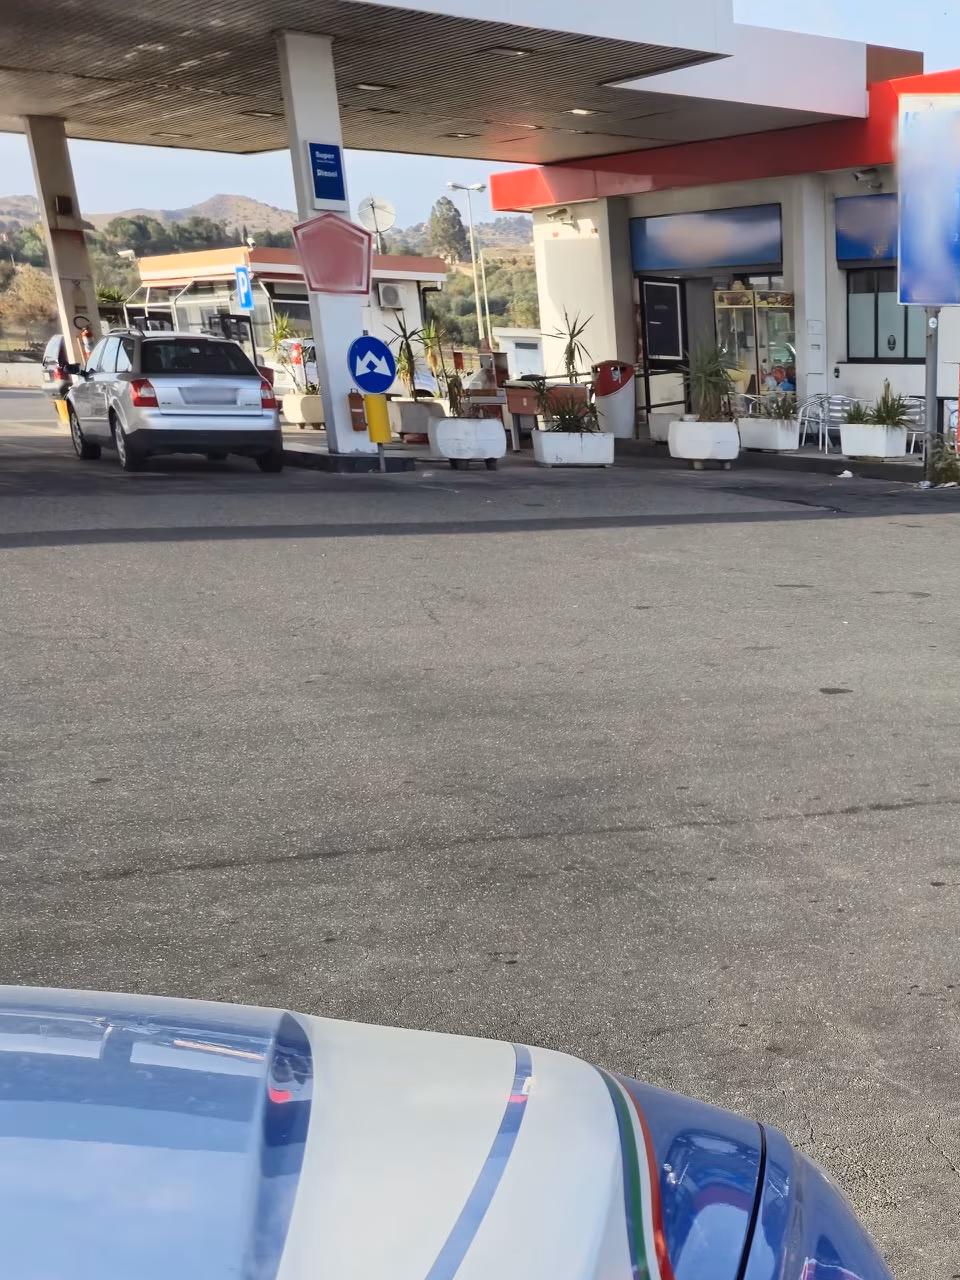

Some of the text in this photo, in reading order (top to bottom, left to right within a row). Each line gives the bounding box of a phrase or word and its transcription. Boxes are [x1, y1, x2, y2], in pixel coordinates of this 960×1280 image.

[315, 151, 335, 160] Super
[316, 169, 338, 178] Diesel
[237, 271, 248, 304] P
